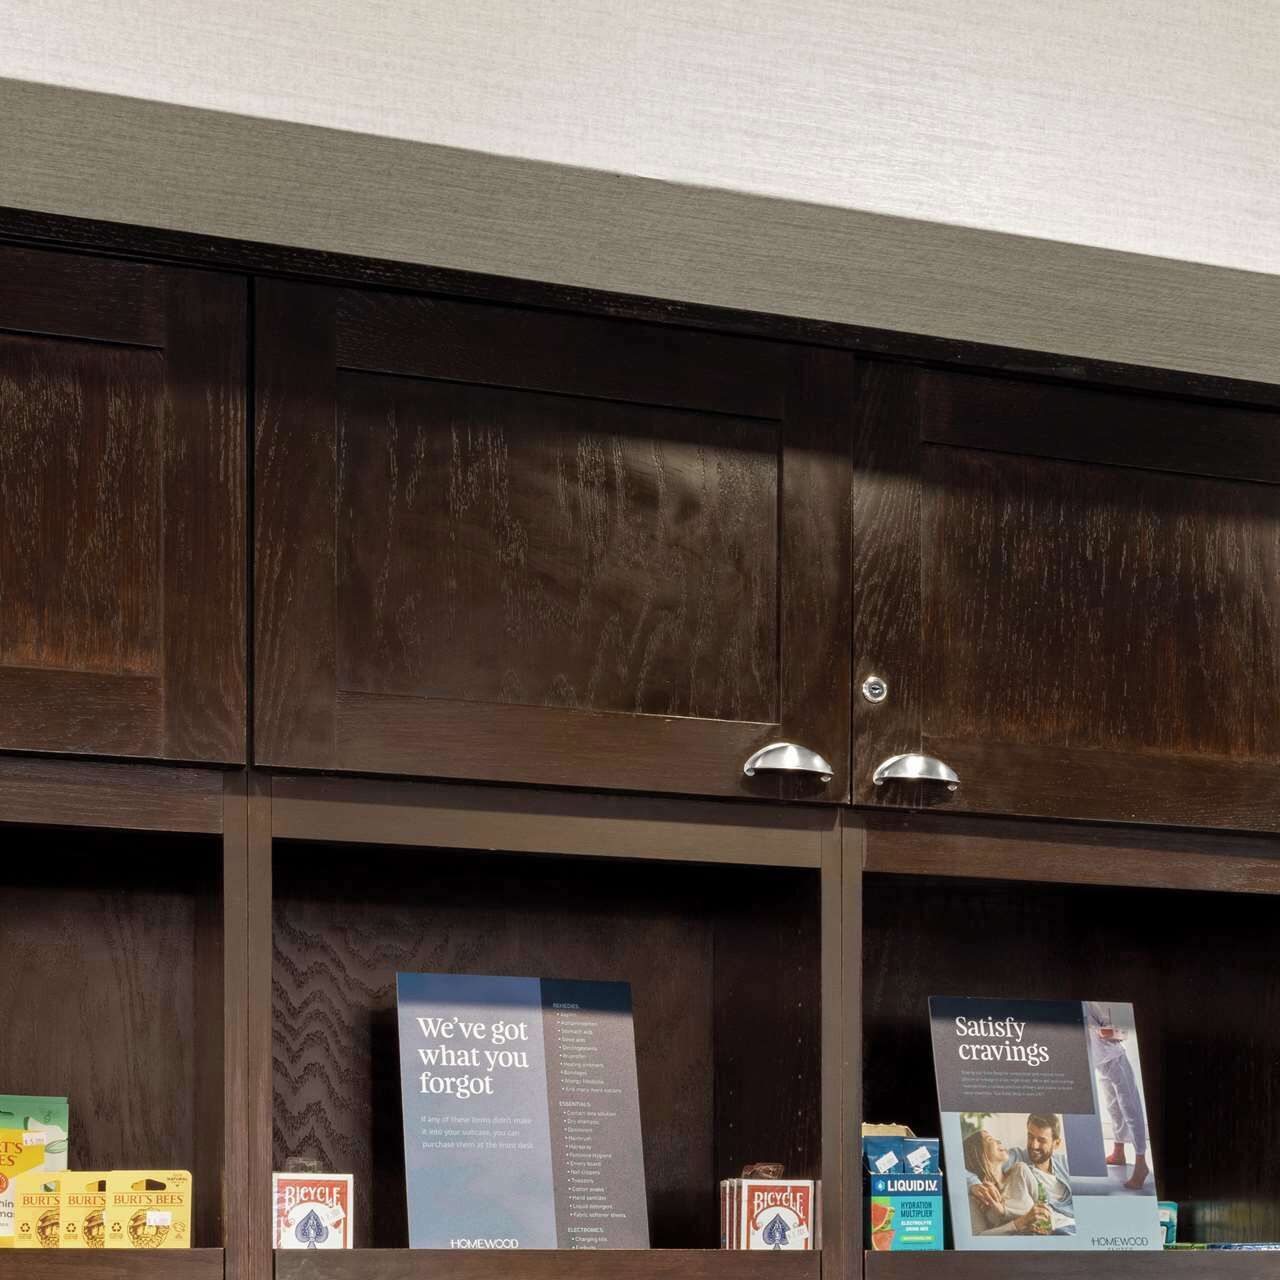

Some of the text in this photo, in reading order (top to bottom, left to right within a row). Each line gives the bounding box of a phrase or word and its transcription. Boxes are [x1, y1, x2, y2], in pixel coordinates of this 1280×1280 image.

[416, 1016, 528, 1045] We've got
[954, 1016, 1027, 1043] Satisfy
[417, 1045, 529, 1071] what you
[958, 1041, 1050, 1067] cravings
[419, 1072, 494, 1099] forgot
[285, 1186, 341, 1208] BICYCLE
[887, 1180, 938, 1192] LIQUID I.V.
[113, 1194, 185, 1206] BURT'S BEES
[753, 1191, 805, 1217] BICYCLE
[900, 1201, 933, 1209] HYDRATION
[900, 1209, 933, 1218] MULTIPLIER
[450, 1238, 519, 1249] HOMEWOOD
[1091, 1236, 1149, 1247] HOMEWOOD
